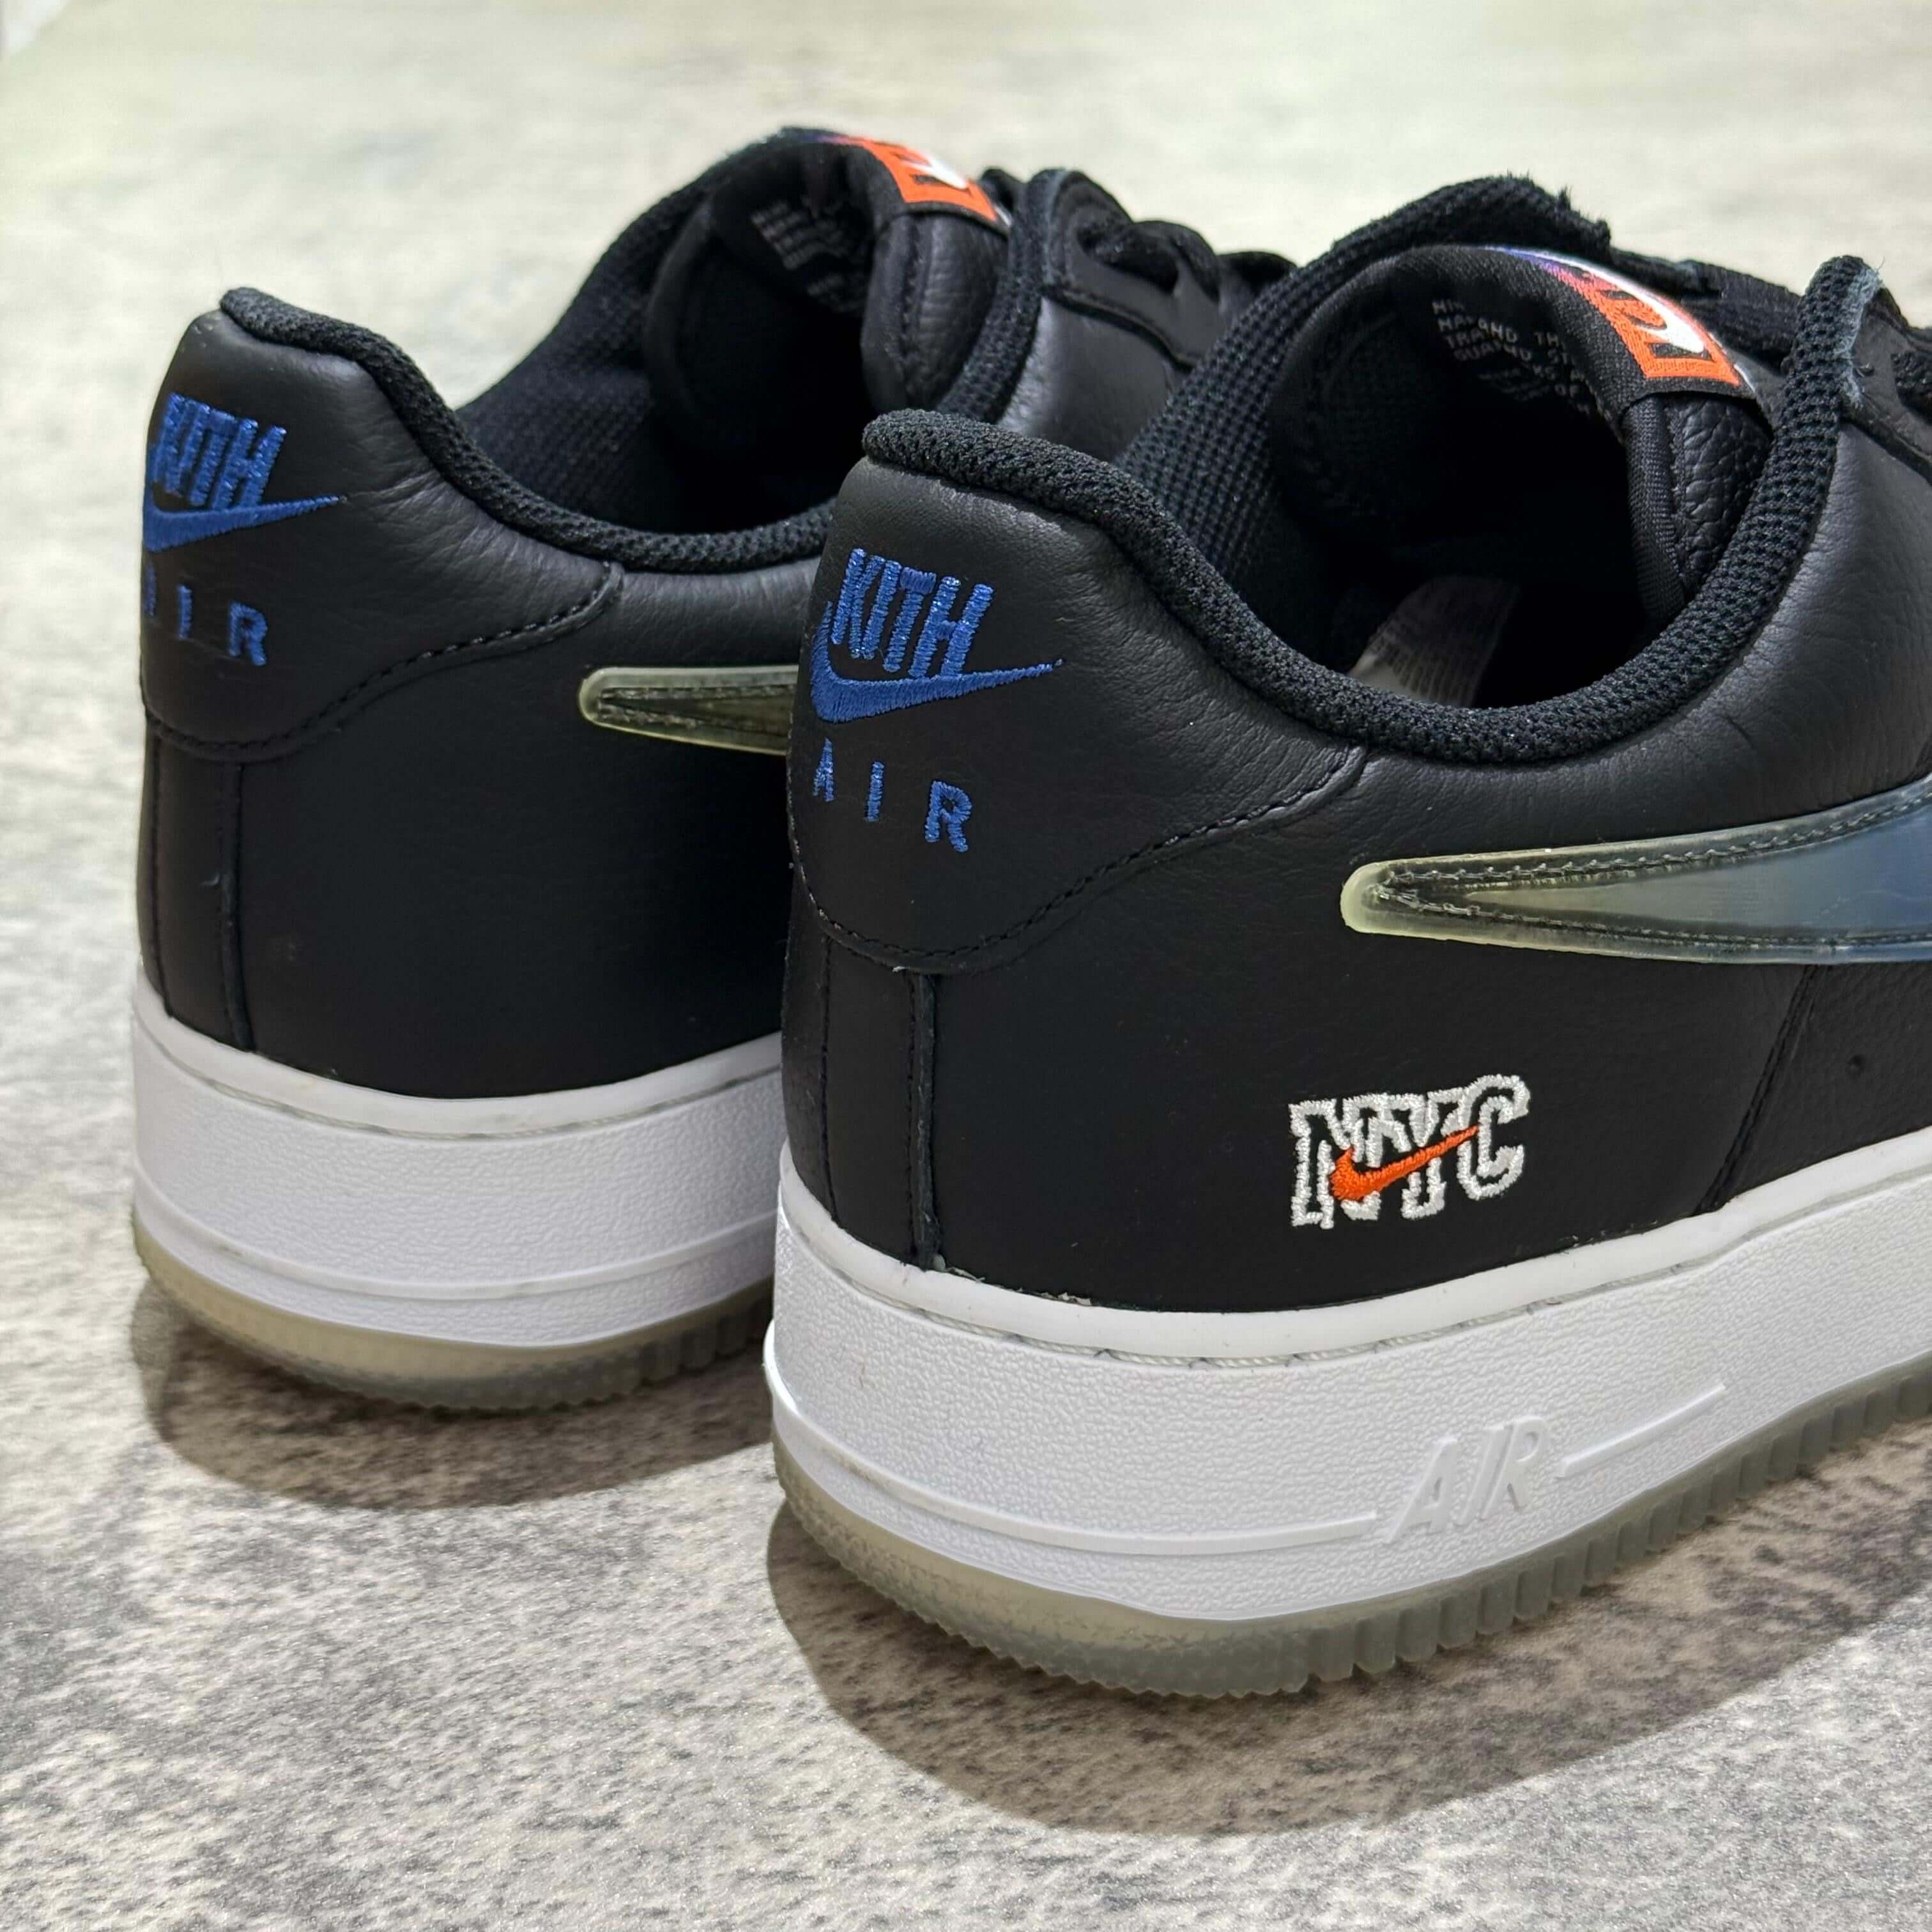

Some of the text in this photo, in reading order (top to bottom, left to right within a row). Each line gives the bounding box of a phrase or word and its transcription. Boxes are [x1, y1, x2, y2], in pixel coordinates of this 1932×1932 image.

[812, 737, 973, 853] AIR
[1288, 1074, 1531, 1229] NYC
[1380, 1414, 1551, 1545] AIR
